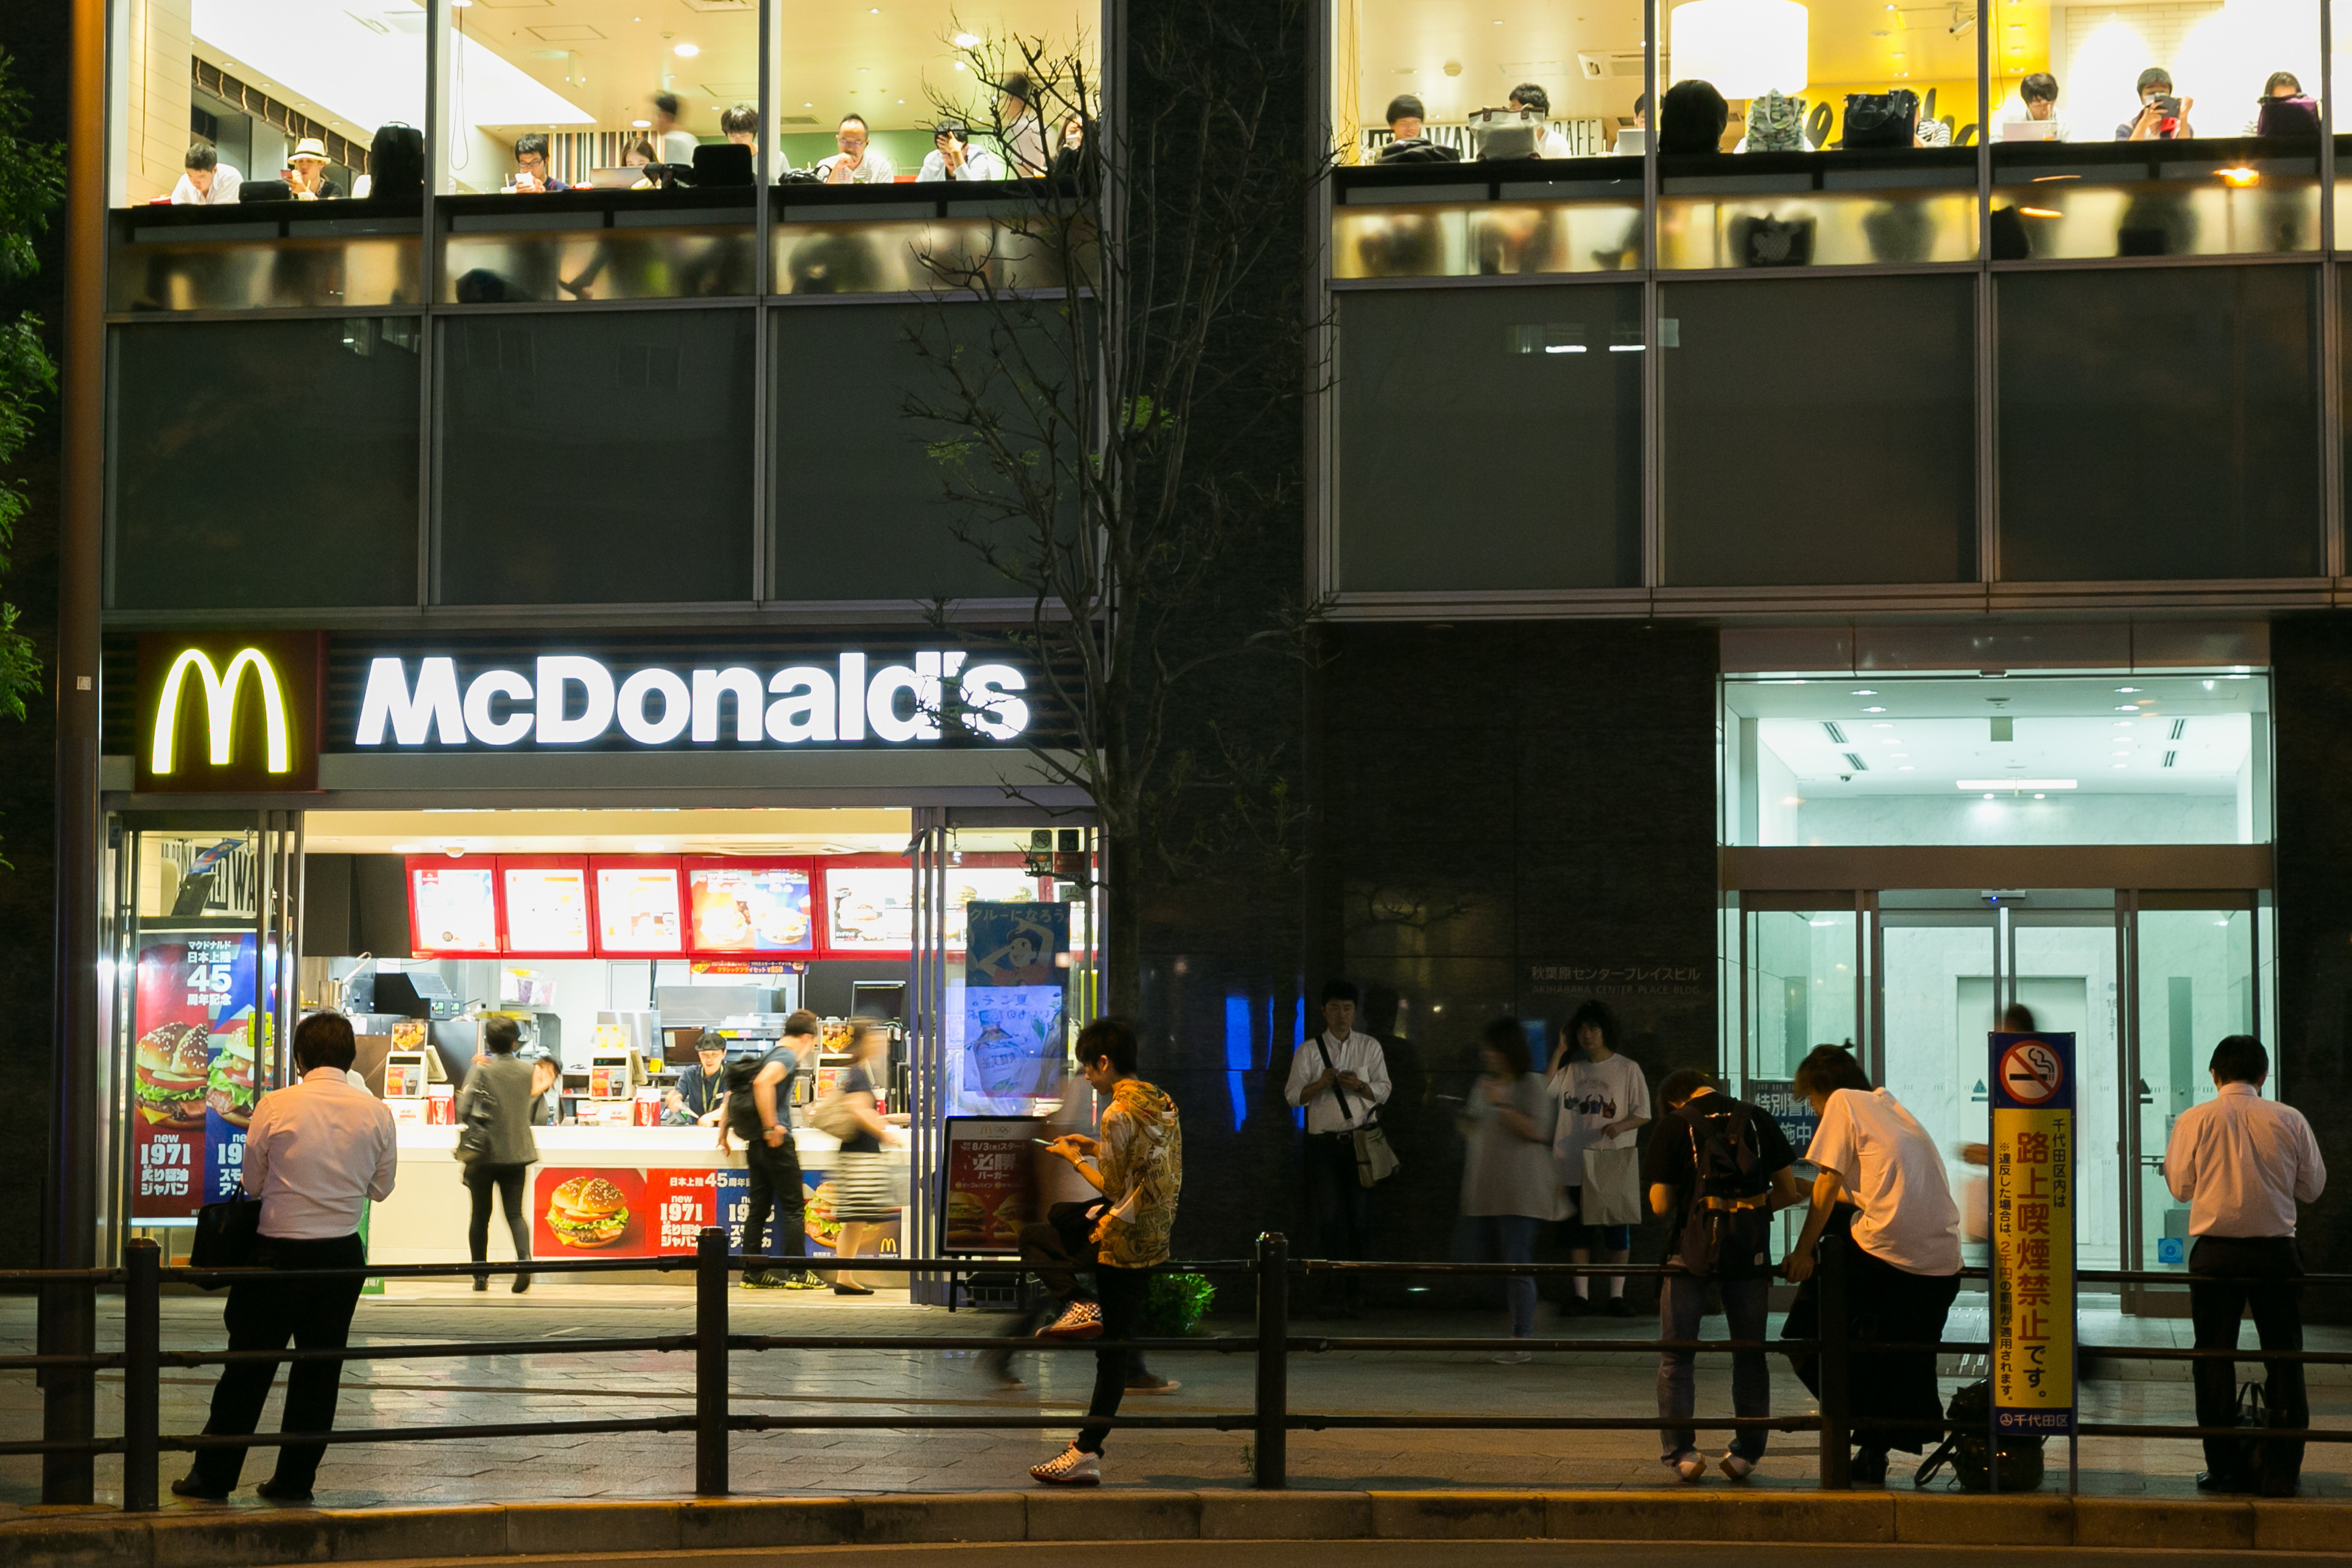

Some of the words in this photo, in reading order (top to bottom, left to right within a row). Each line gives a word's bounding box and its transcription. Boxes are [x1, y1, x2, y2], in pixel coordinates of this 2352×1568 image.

[355, 651, 1031, 746] McDonald's
[188, 940, 231, 950] マクドナルド
[188, 951, 231, 964] 日本上陸
[186, 964, 232, 993] 45
[1531, 966, 1700, 981] 秋葉原センタープレイスビル
[1532, 985, 1591, 994] AKIHABARA
[1595, 985, 1633, 994] CENTER
[1638, 985, 1669, 994] PLACE
[186, 993, 232, 1006] 周年記念
[154, 1134, 179, 1143] new
[232, 1134, 247, 1143] ne
[1779, 1121, 1812, 1146] 施中
[140, 1143, 191, 1165] 1971
[217, 1143, 245, 1165] 19
[972, 1153, 1016, 1171] 必勝
[2052, 1118, 2066, 1209] 千代田区内は
[669, 1172, 750, 1188] 日本上陸45周年
[141, 1182, 189, 1196] ジャパン
[660, 1203, 703, 1221] 1971
[2016, 1131, 2051, 1398] 路上喫煙禁止です。
[2013, 1414, 2069, 1427] 千代田区
